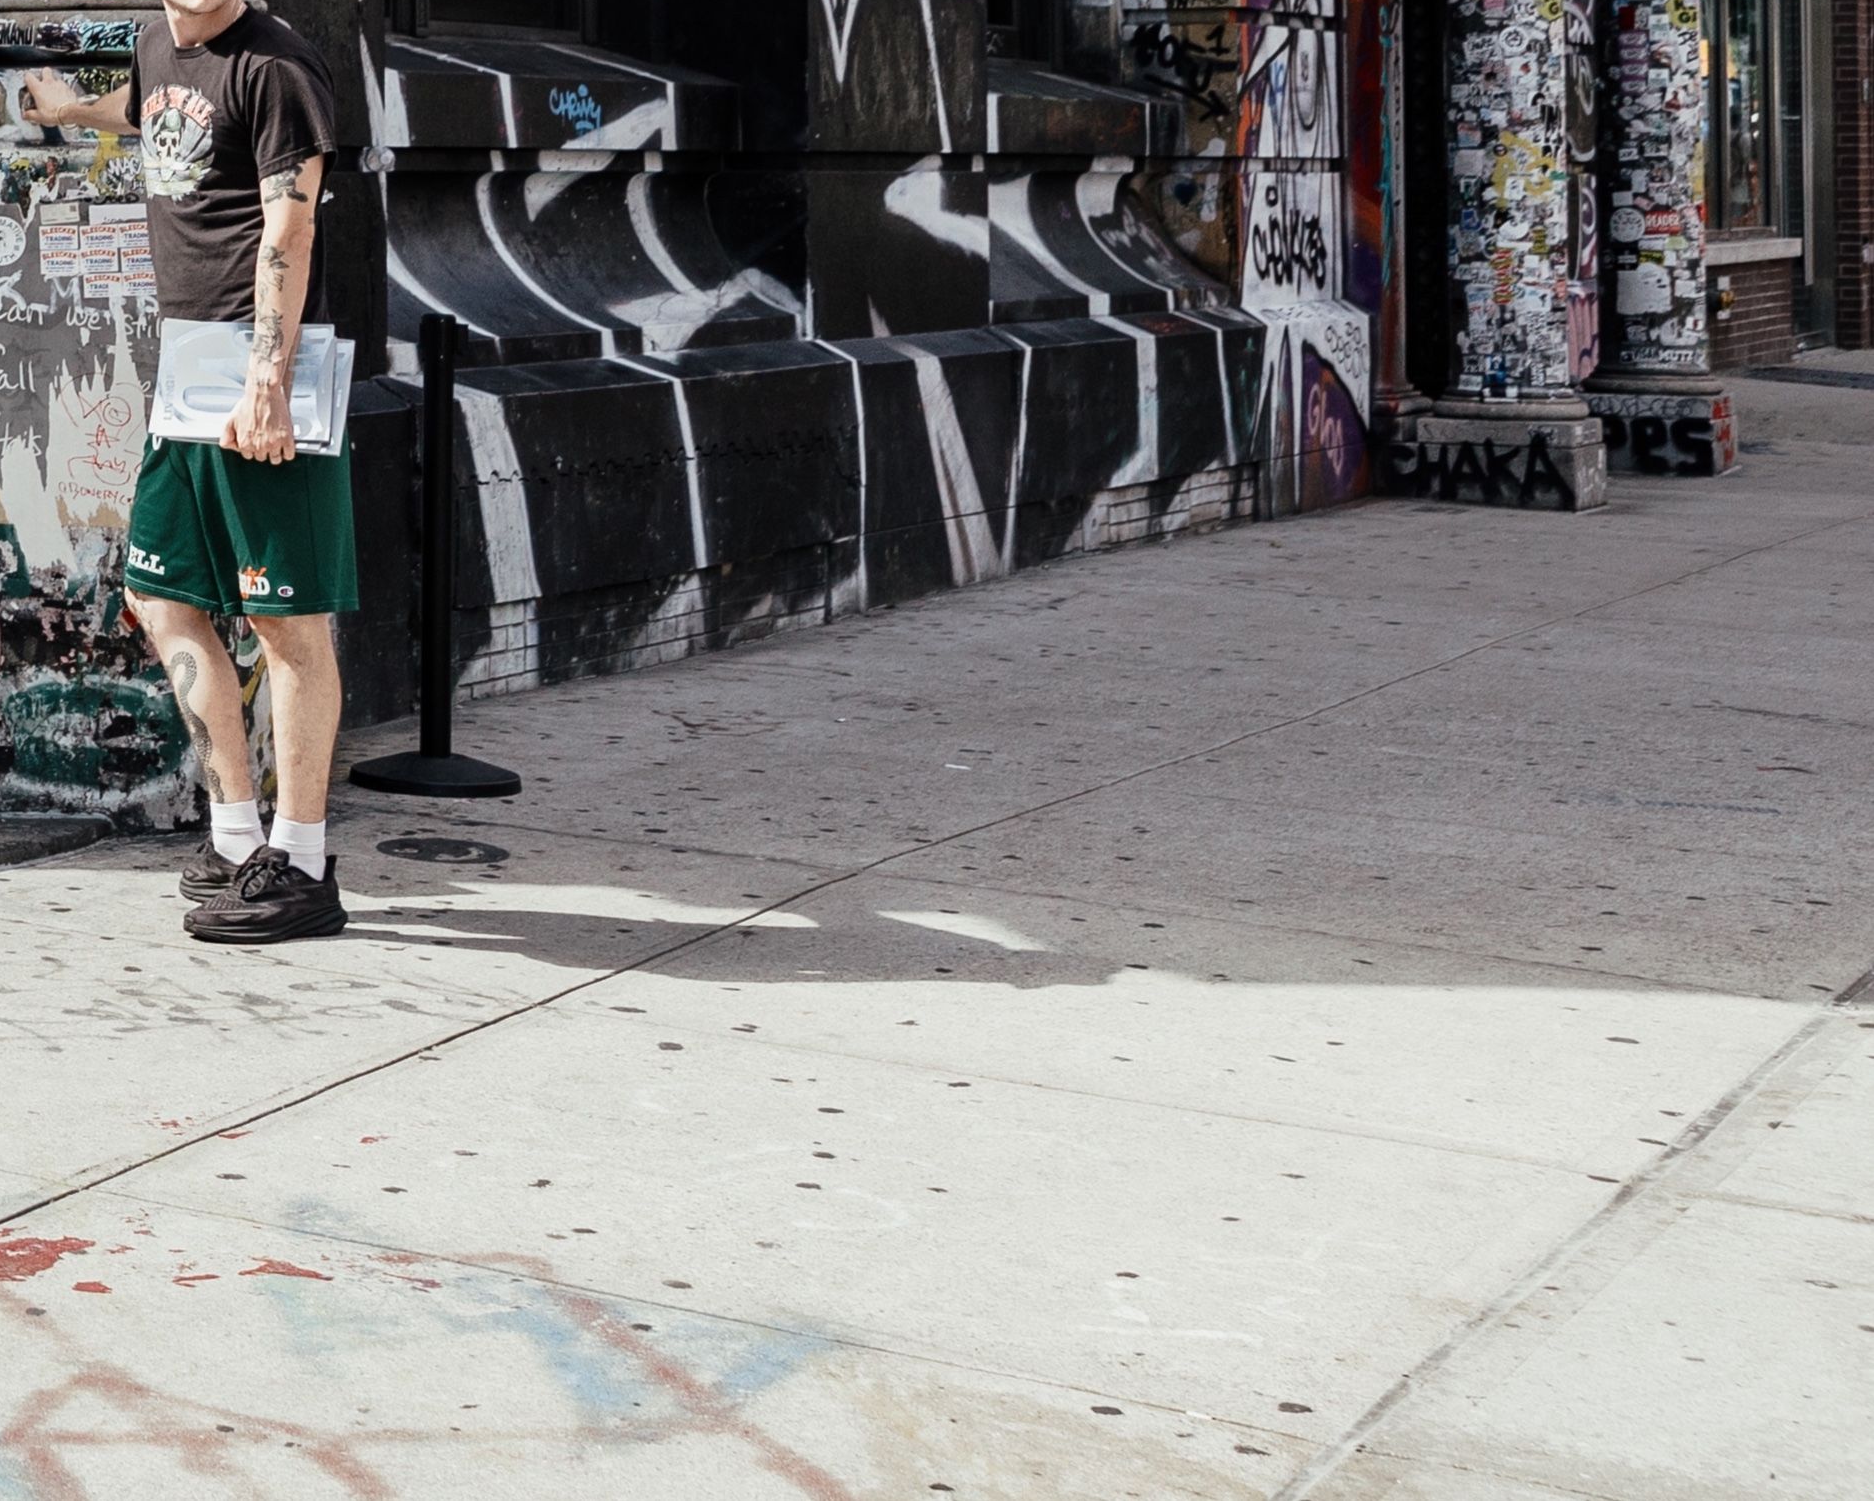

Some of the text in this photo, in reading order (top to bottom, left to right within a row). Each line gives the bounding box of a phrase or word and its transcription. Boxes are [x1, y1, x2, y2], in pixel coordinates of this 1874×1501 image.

[41, 226, 77, 236] BLEECKER
[81, 226, 116, 236] BLEECKER
[41, 251, 77, 261] BLEECKER
[81, 250, 116, 260] BLEECKER
[85, 274, 121, 284] BLEECKER
[129, 545, 165, 576] ELL
